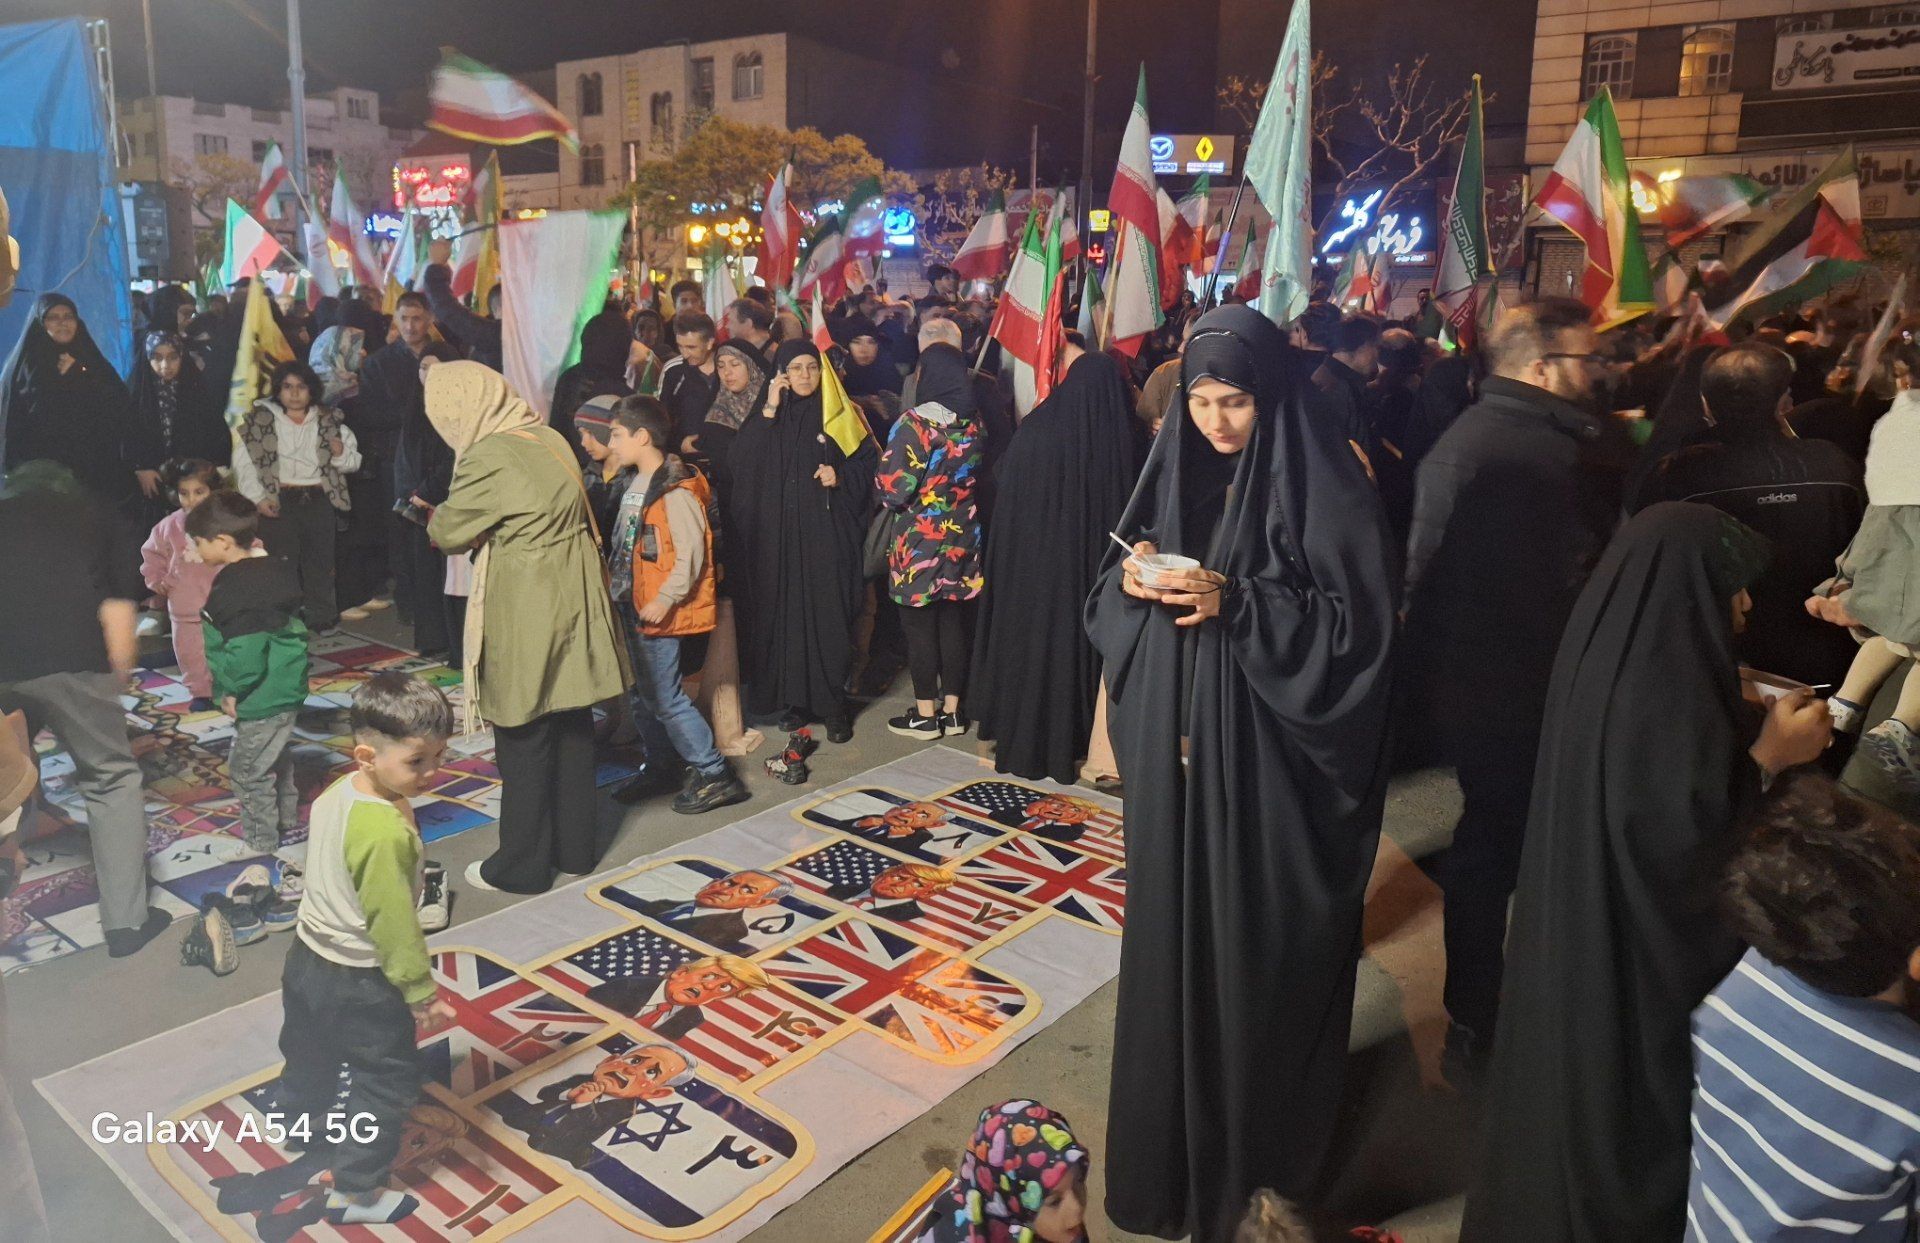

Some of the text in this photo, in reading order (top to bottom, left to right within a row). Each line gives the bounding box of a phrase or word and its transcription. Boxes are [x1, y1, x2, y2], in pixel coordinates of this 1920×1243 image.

[1757, 492, 1798, 504] adidas
[933, 832, 973, 849] ۸
[748, 913, 795, 934] ۵
[971, 902, 1017, 924] ۷
[751, 1010, 818, 1039] ۴
[498, 1022, 569, 1052] ۲
[684, 1135, 773, 1175] ۳
